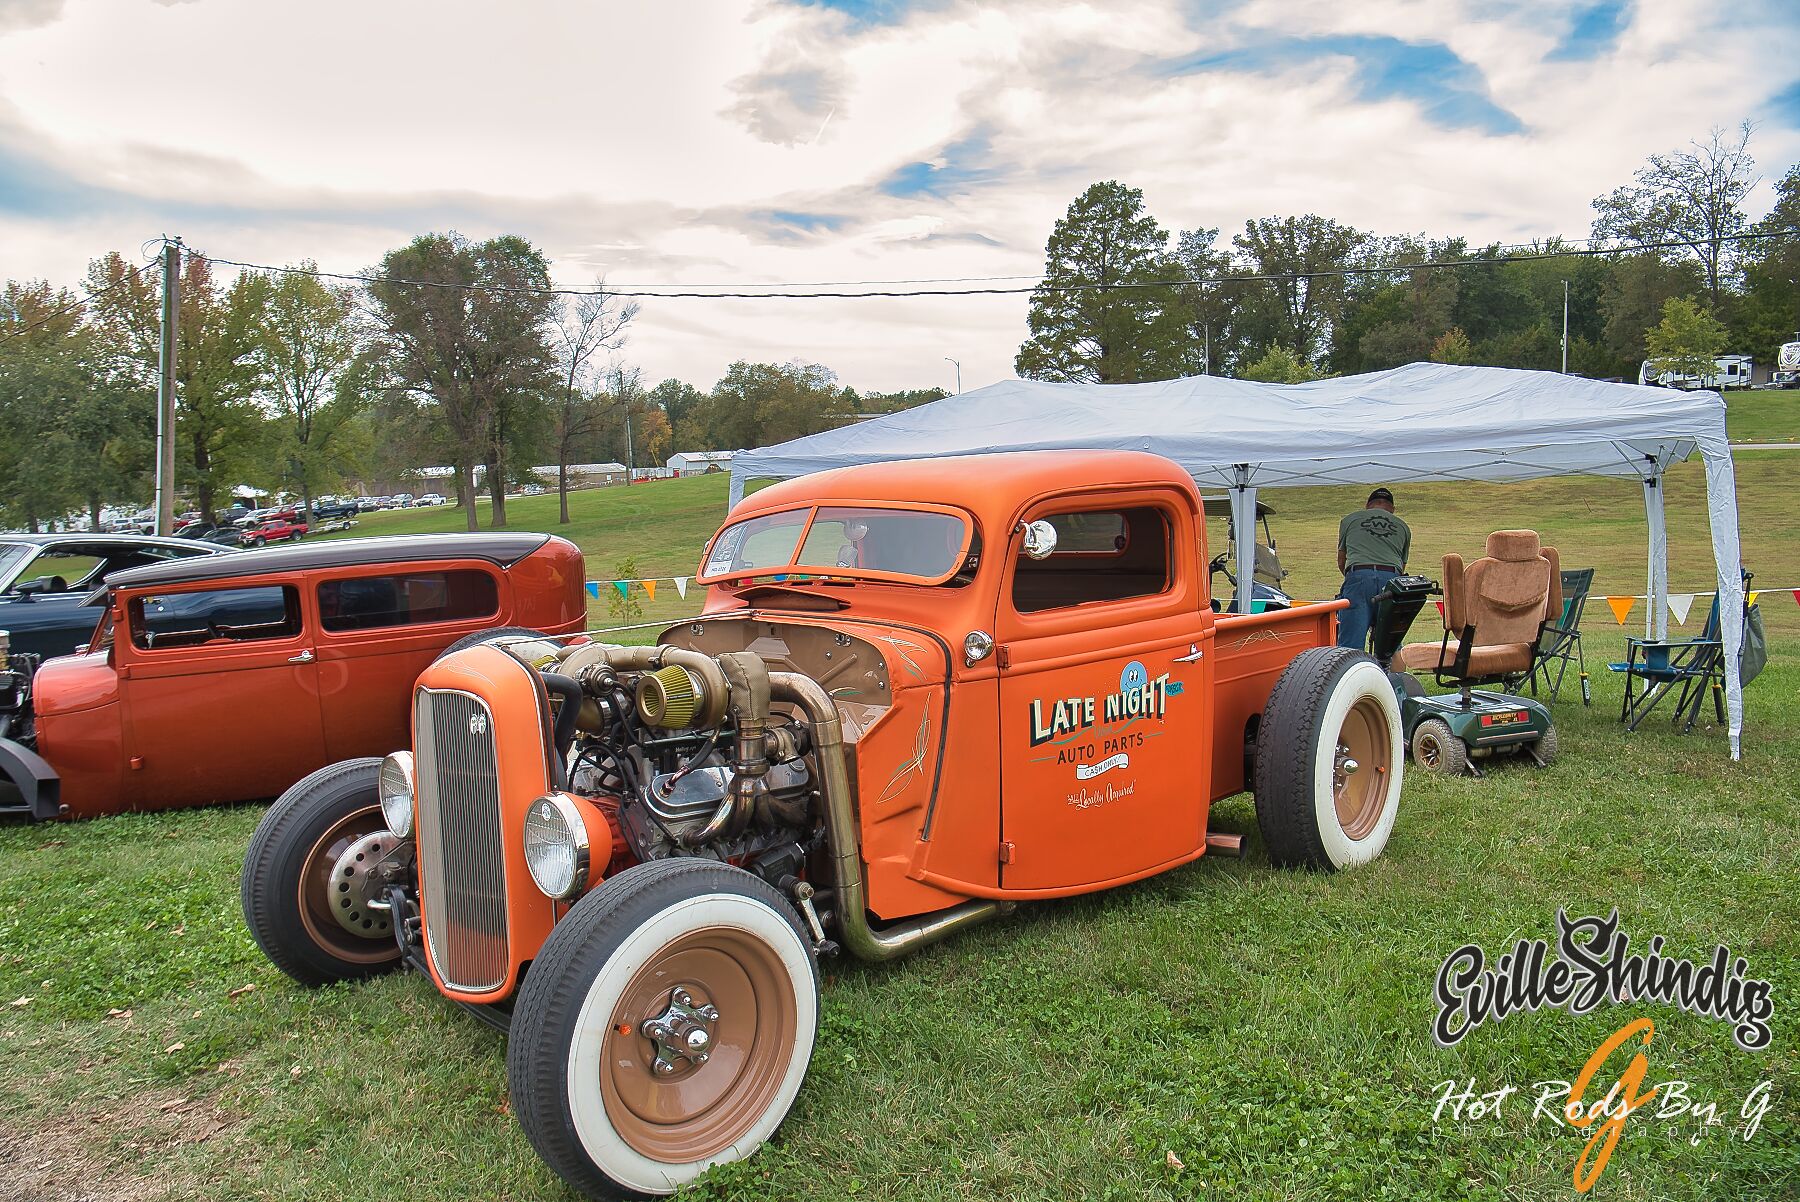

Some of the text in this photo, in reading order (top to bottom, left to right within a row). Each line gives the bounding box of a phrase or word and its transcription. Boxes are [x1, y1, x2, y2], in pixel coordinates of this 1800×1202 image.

[1029, 673, 1170, 748] LATE NIGHT
[1057, 732, 1144, 765] AUTO PARTS
[1085, 764, 1103, 776] CASH
